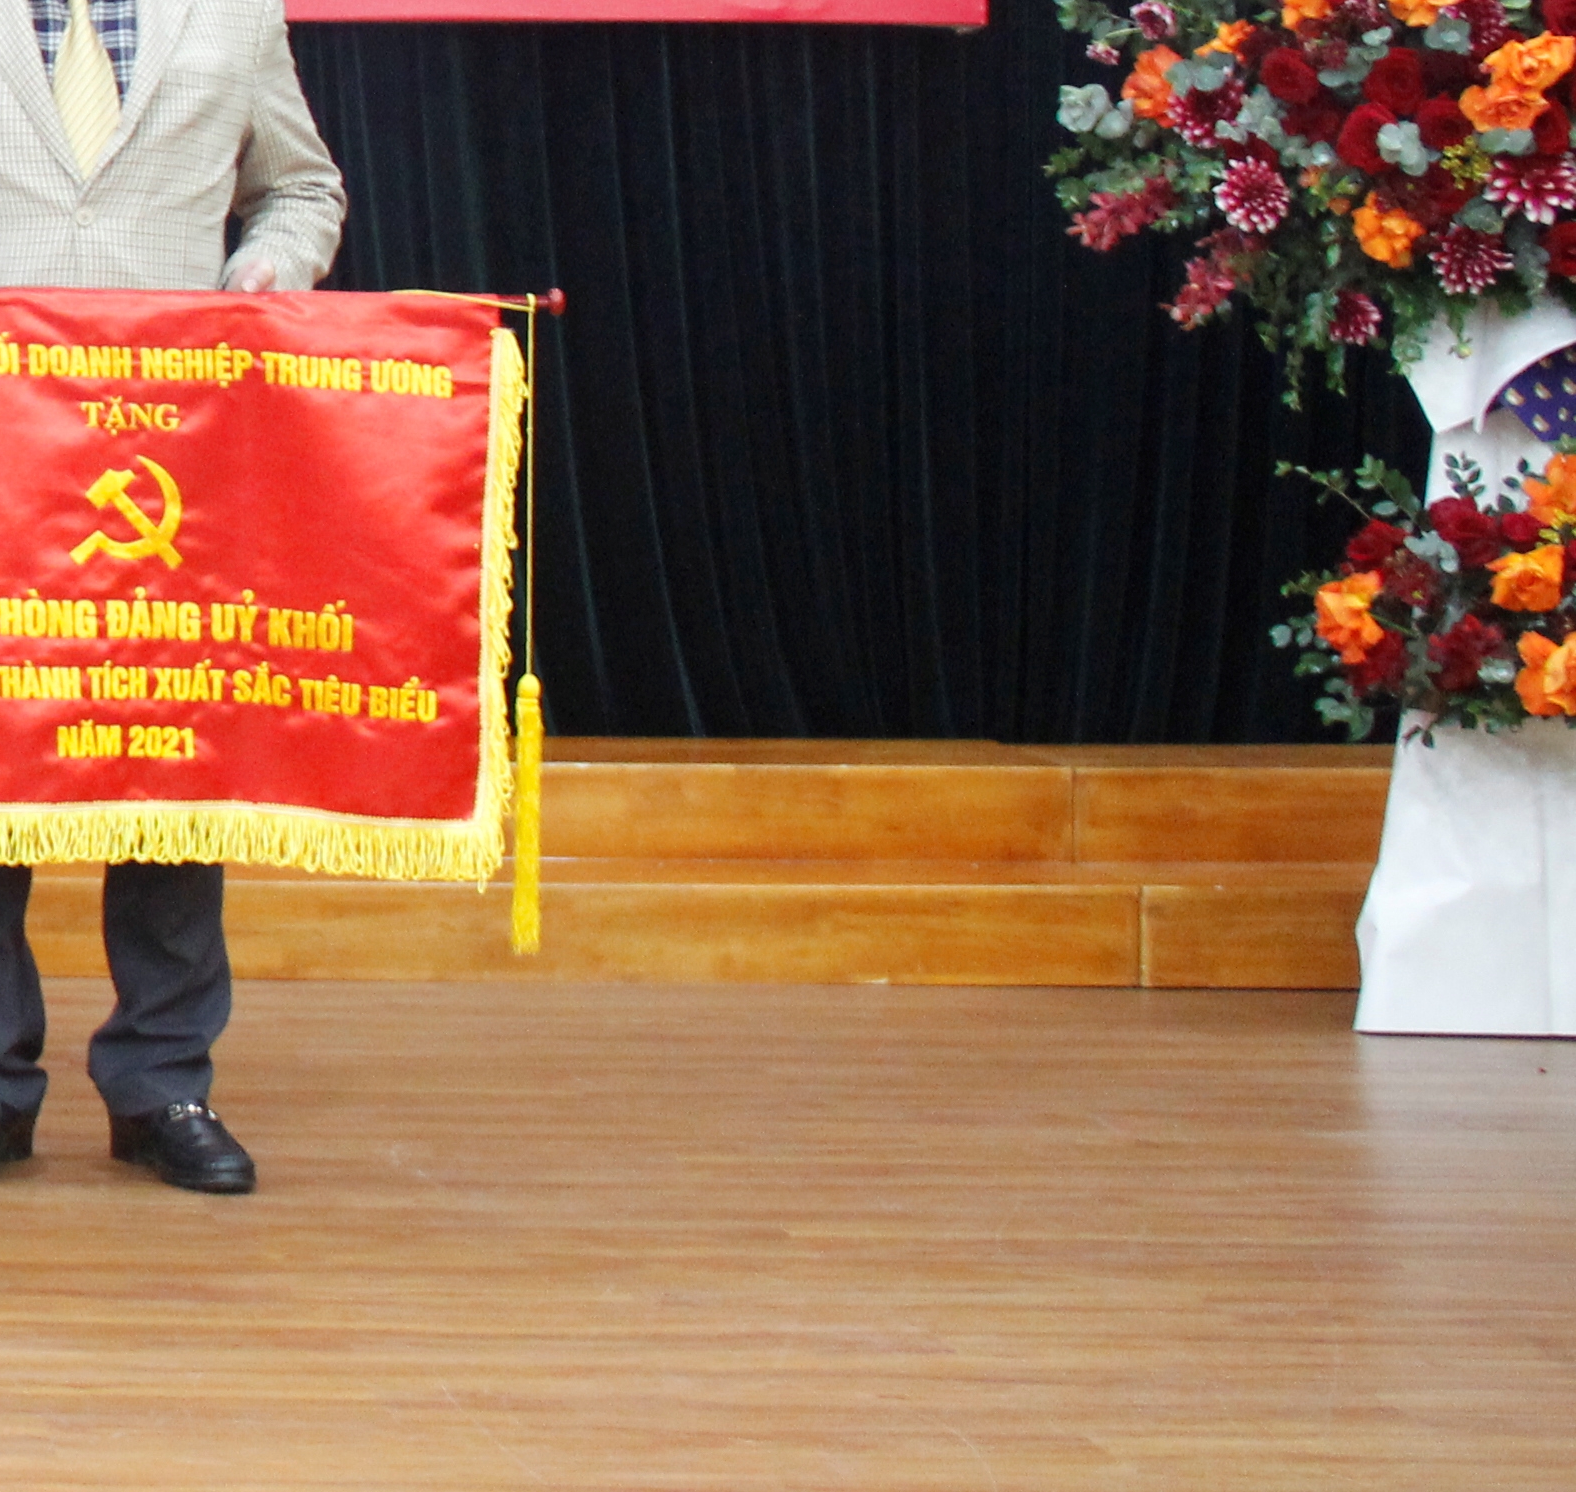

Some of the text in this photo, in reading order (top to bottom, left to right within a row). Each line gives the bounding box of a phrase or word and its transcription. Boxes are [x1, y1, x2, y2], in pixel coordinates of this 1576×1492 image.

[27, 344, 132, 379] DOANH
[140, 342, 253, 388] NGHIỆP
[260, 351, 362, 392] TRUNG
[370, 358, 453, 399] ƯƠNG
[80, 395, 180, 436] TẶNG
[105, 586, 201, 642] ĐẢNG
[268, 600, 353, 652] KHỐI
[86, 660, 147, 700] TÍCH
[153, 658, 225, 702] XUẤT
[232, 661, 292, 708] SẮC
[298, 674, 361, 717] TIÊU
[368, 676, 438, 723] BIỂU
[57, 719, 195, 759] NĂM 2021
